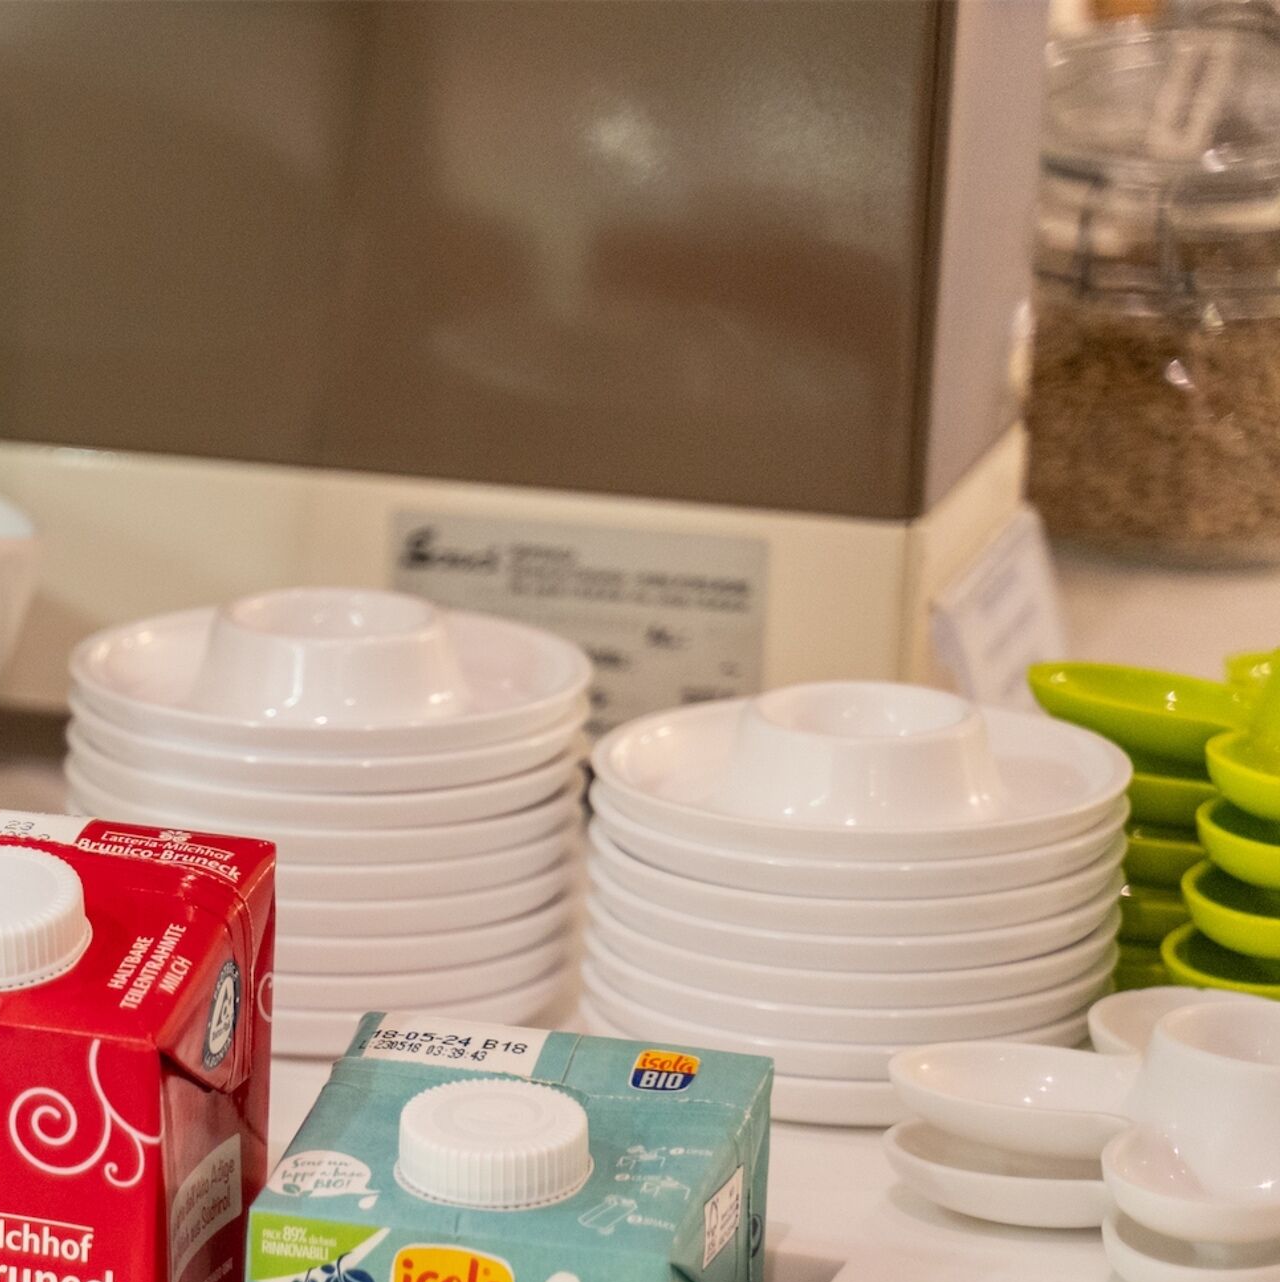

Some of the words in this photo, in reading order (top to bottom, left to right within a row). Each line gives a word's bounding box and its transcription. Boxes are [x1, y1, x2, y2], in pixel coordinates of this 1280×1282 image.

[101, 830, 236, 862] Latteria-Milchhof
[76, 837, 242, 880] Brunico-Bruneck
[107, 936, 154, 990] HALTBARE
[119, 923, 187, 1010] TEILENTRAHMTE
[158, 955, 193, 995] MILCH
[372, 1029, 473, 1048] 18-05-24
[425, 1044, 489, 1063] 03:39:43
[640, 1052, 695, 1074] isola
[638, 1070, 685, 1091] BIO
[281, 1225, 308, 1242] 89%
[261, 1239, 330, 1262] RINNOVABILI
